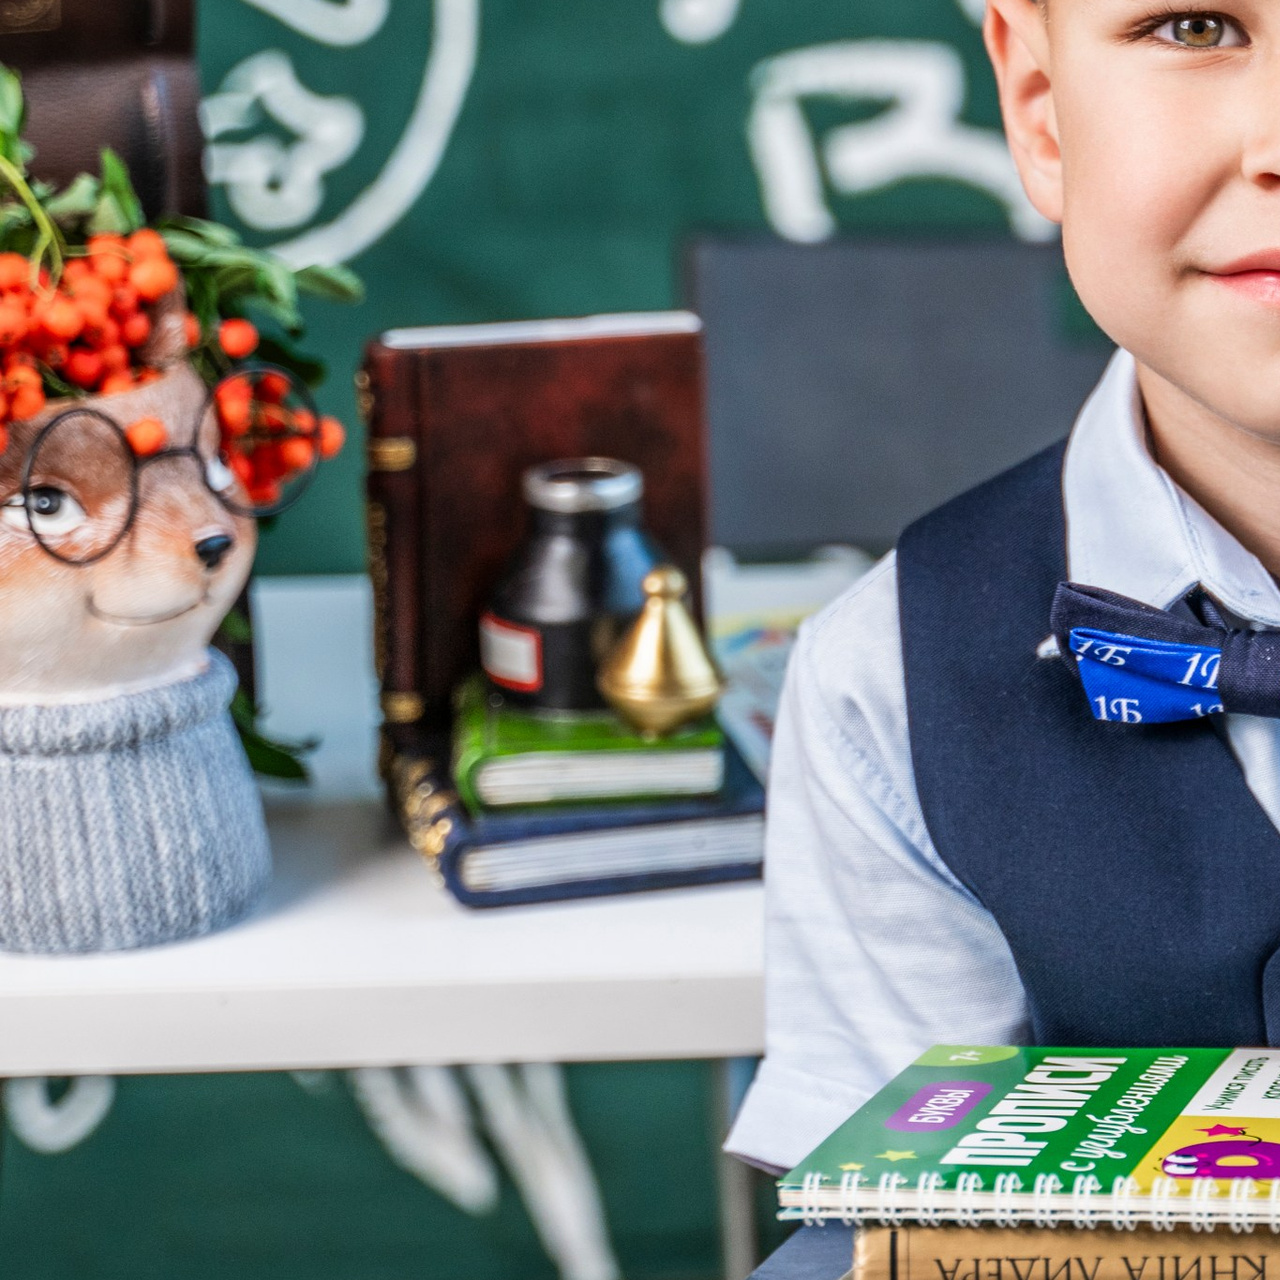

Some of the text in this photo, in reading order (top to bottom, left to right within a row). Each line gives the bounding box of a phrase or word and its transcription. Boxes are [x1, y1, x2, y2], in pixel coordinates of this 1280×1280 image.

[1094, 694, 1143, 724] 1Б
[949, 1049, 983, 1062] 7+
[907, 1088, 975, 1124] БУКВЫ
[1202, 1056, 1270, 1111] Учимся писать
[939, 1056, 1128, 1167] ПРОПИСИ
[1070, 1055, 1190, 1160] углублениями
